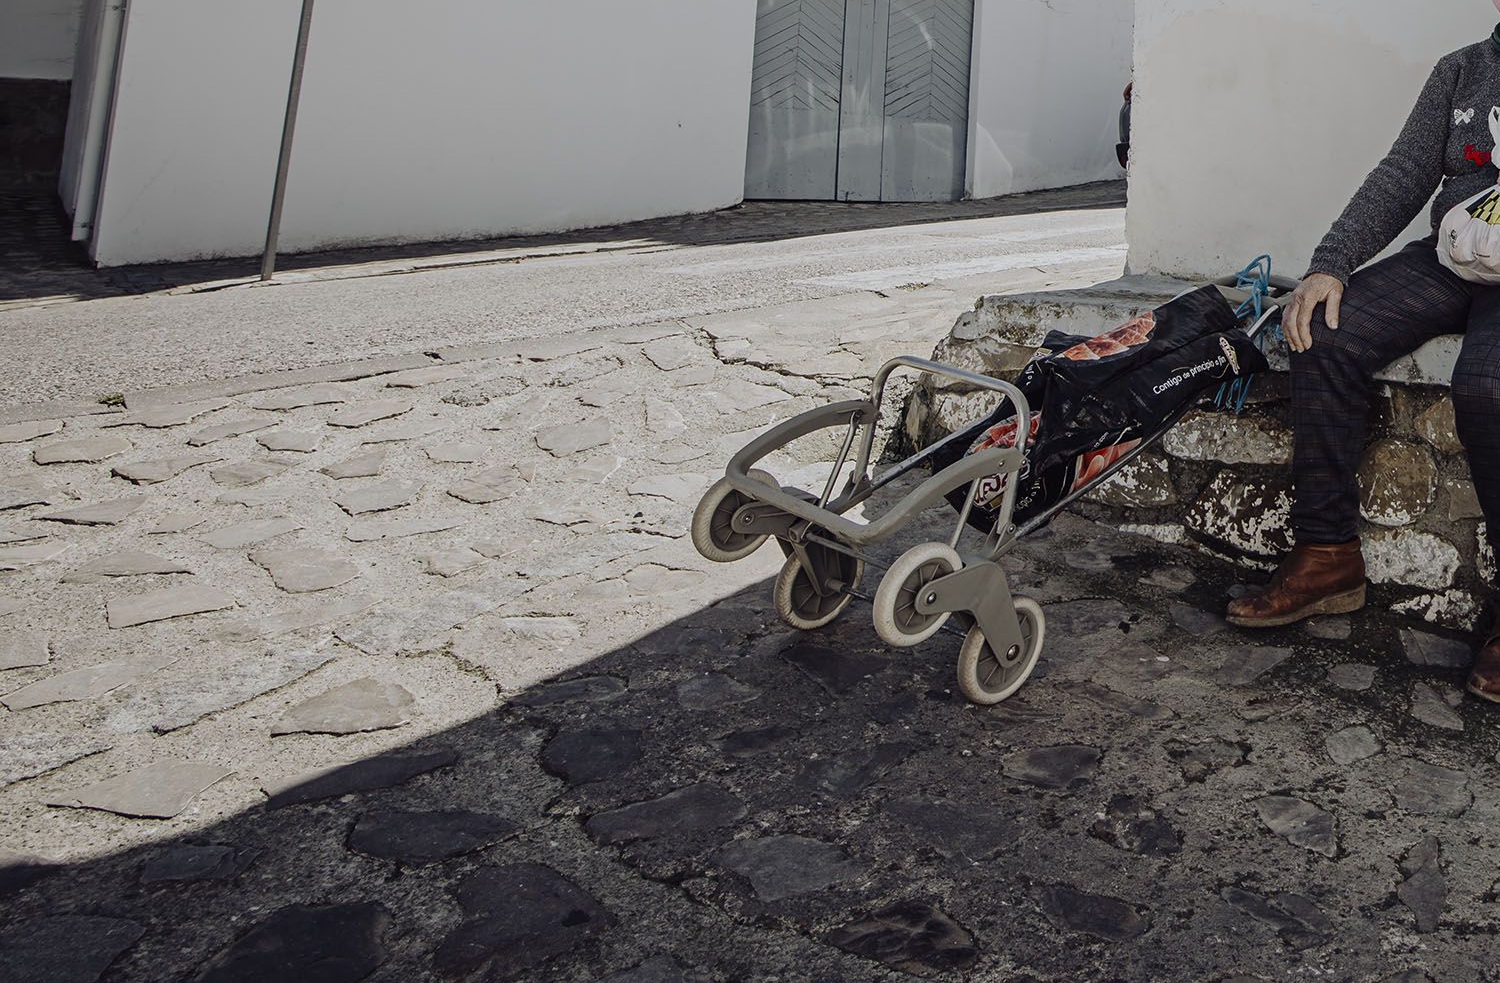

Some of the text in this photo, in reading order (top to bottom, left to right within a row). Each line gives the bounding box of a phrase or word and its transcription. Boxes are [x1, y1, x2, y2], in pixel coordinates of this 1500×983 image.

[1153, 375, 1183, 394] Contigo
[1189, 359, 1215, 377] principio
[1218, 355, 1227, 366] fin
